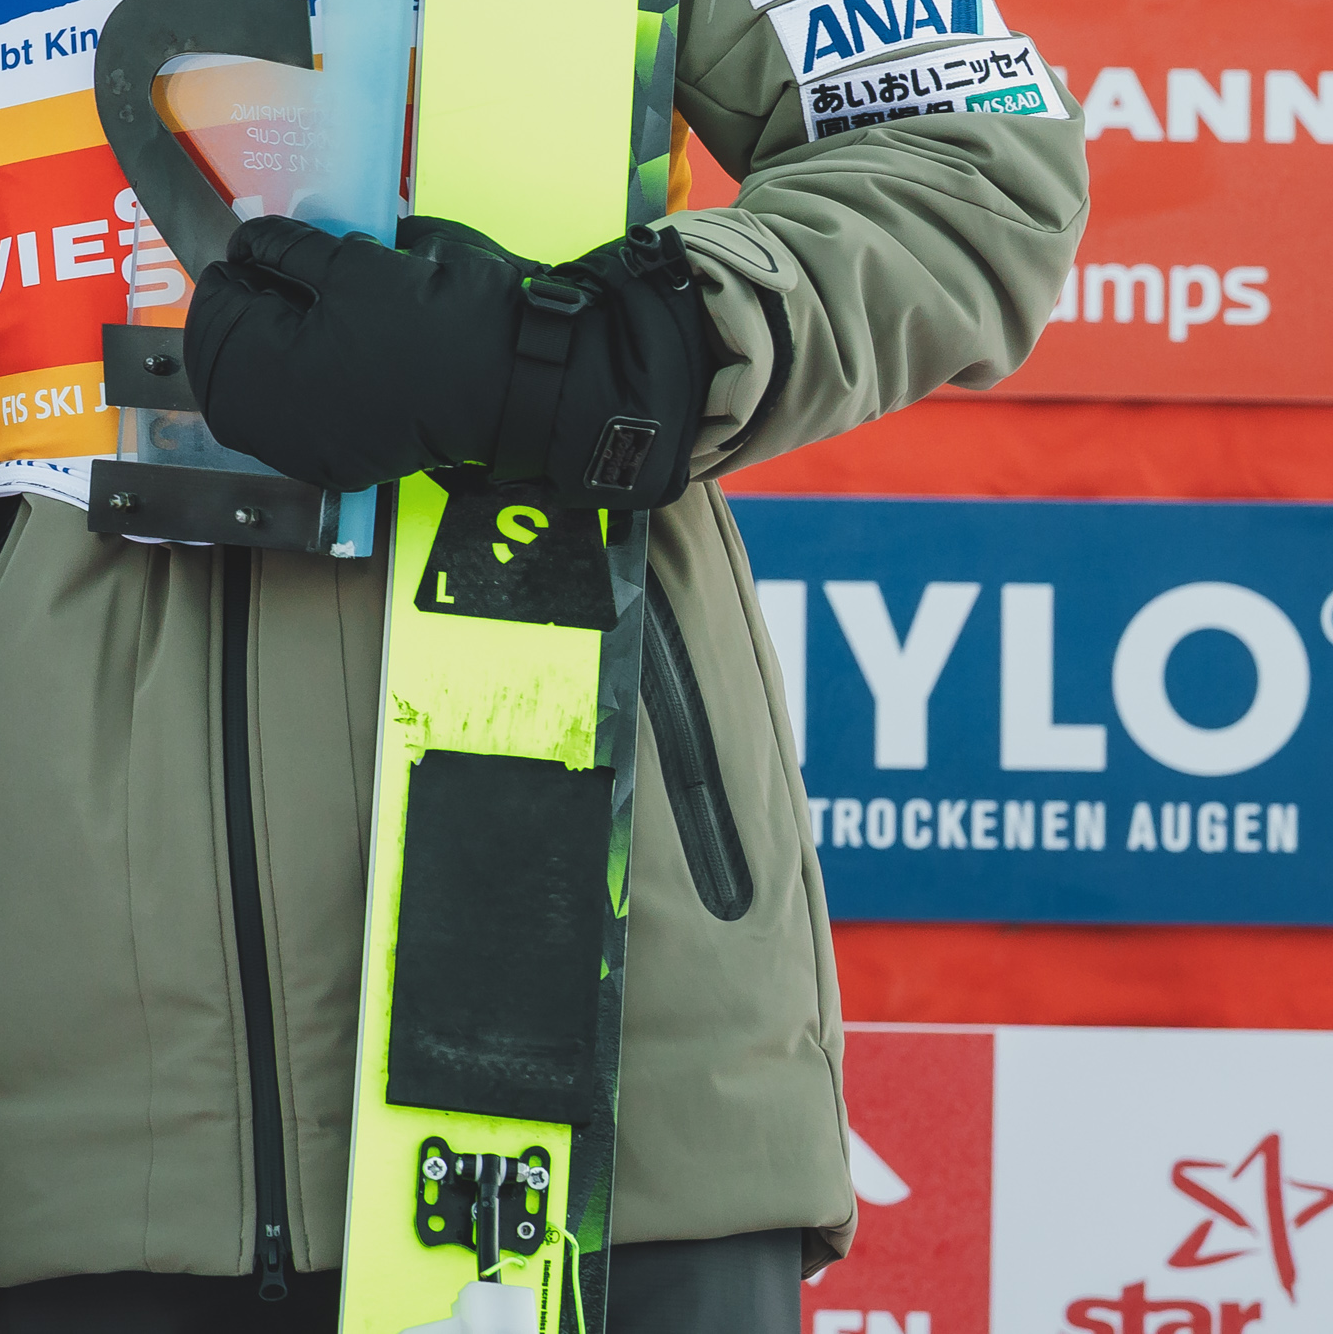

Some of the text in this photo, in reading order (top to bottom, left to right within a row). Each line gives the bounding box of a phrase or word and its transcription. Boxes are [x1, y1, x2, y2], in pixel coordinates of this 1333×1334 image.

[809, 46, 1031, 113] あいおいニッセイ
[1, 393, 29, 427] FIS
[34, 384, 85, 420] SKI
[1126, 800, 1300, 853] AUGEN
